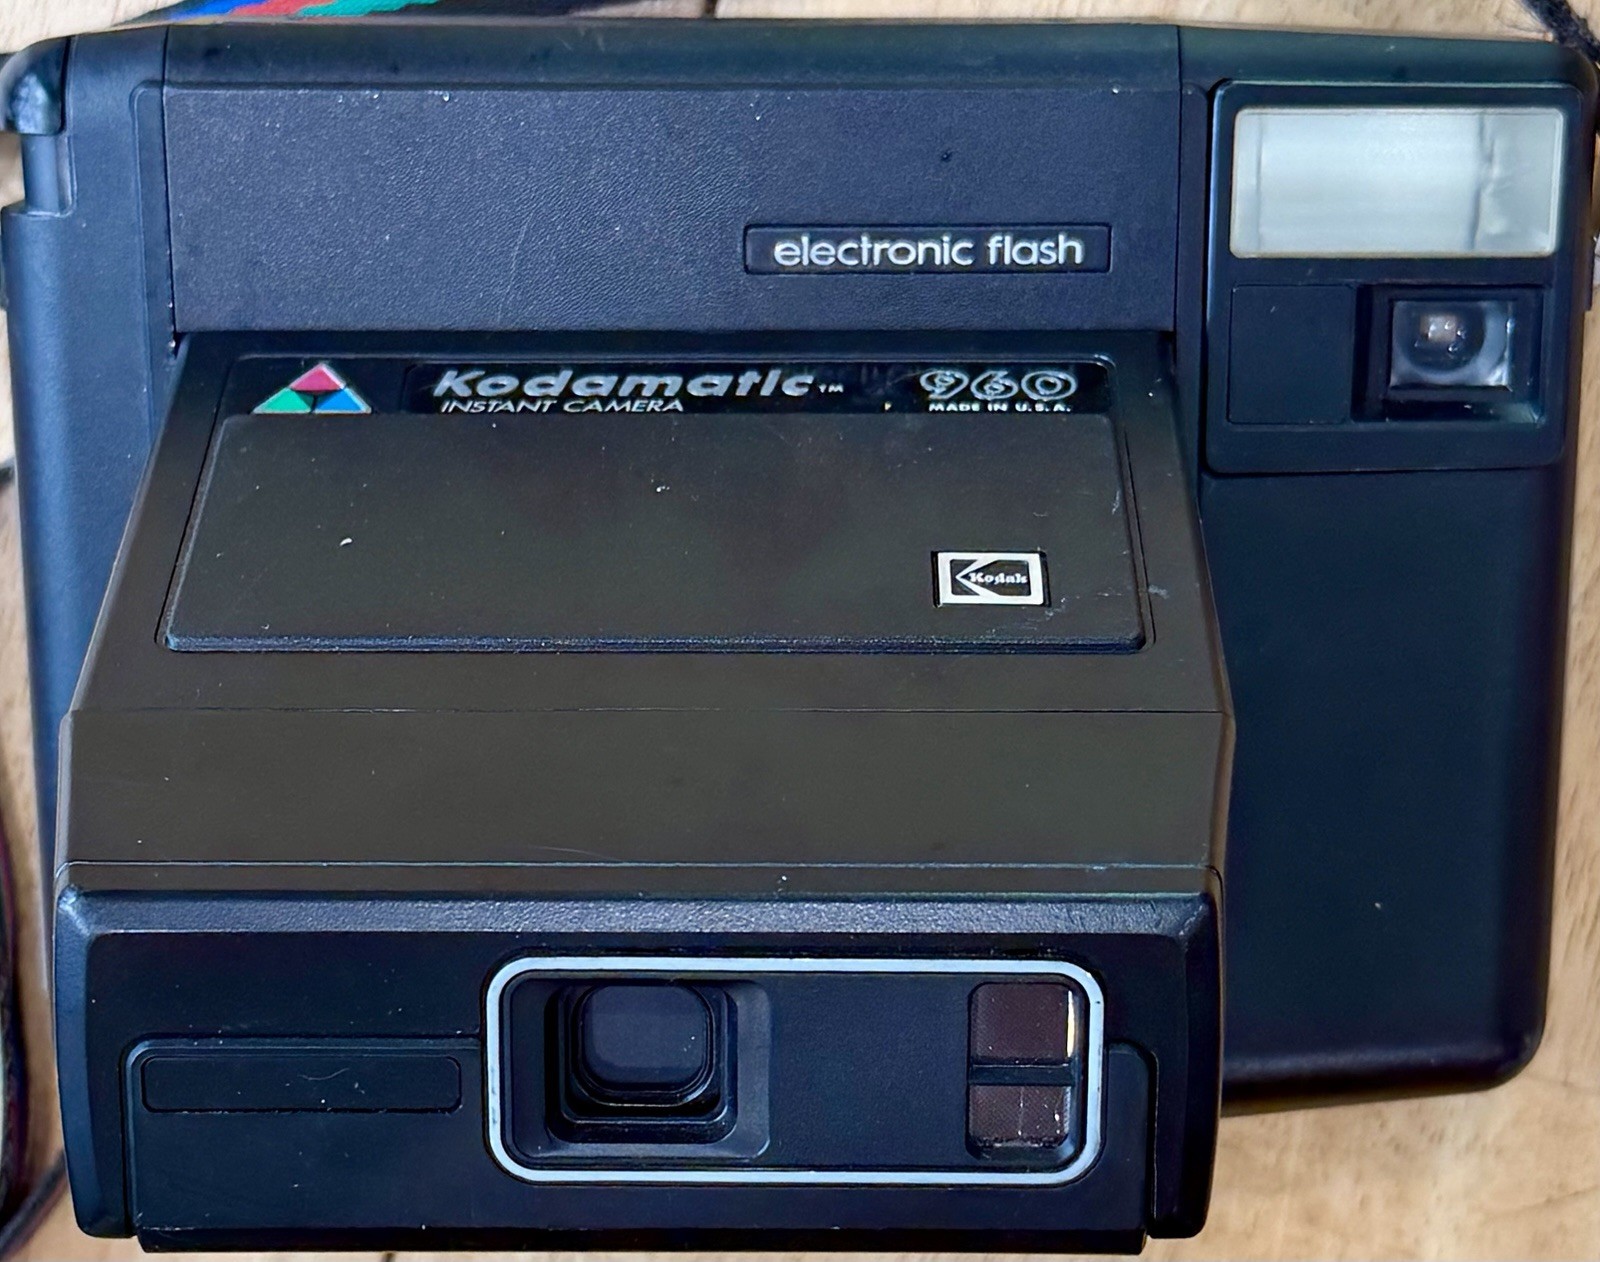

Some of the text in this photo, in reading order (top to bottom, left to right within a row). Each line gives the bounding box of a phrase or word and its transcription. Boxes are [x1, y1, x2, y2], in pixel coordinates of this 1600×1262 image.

[773, 232, 1085, 267] electronic flash
[432, 369, 815, 398] Kodamatic
[919, 369, 1079, 401] 960
[439, 399, 685, 413] INSTANT CAMERA
[928, 402, 1072, 412] MADE IN U.S.A.
[967, 571, 1029, 585] Kodak
